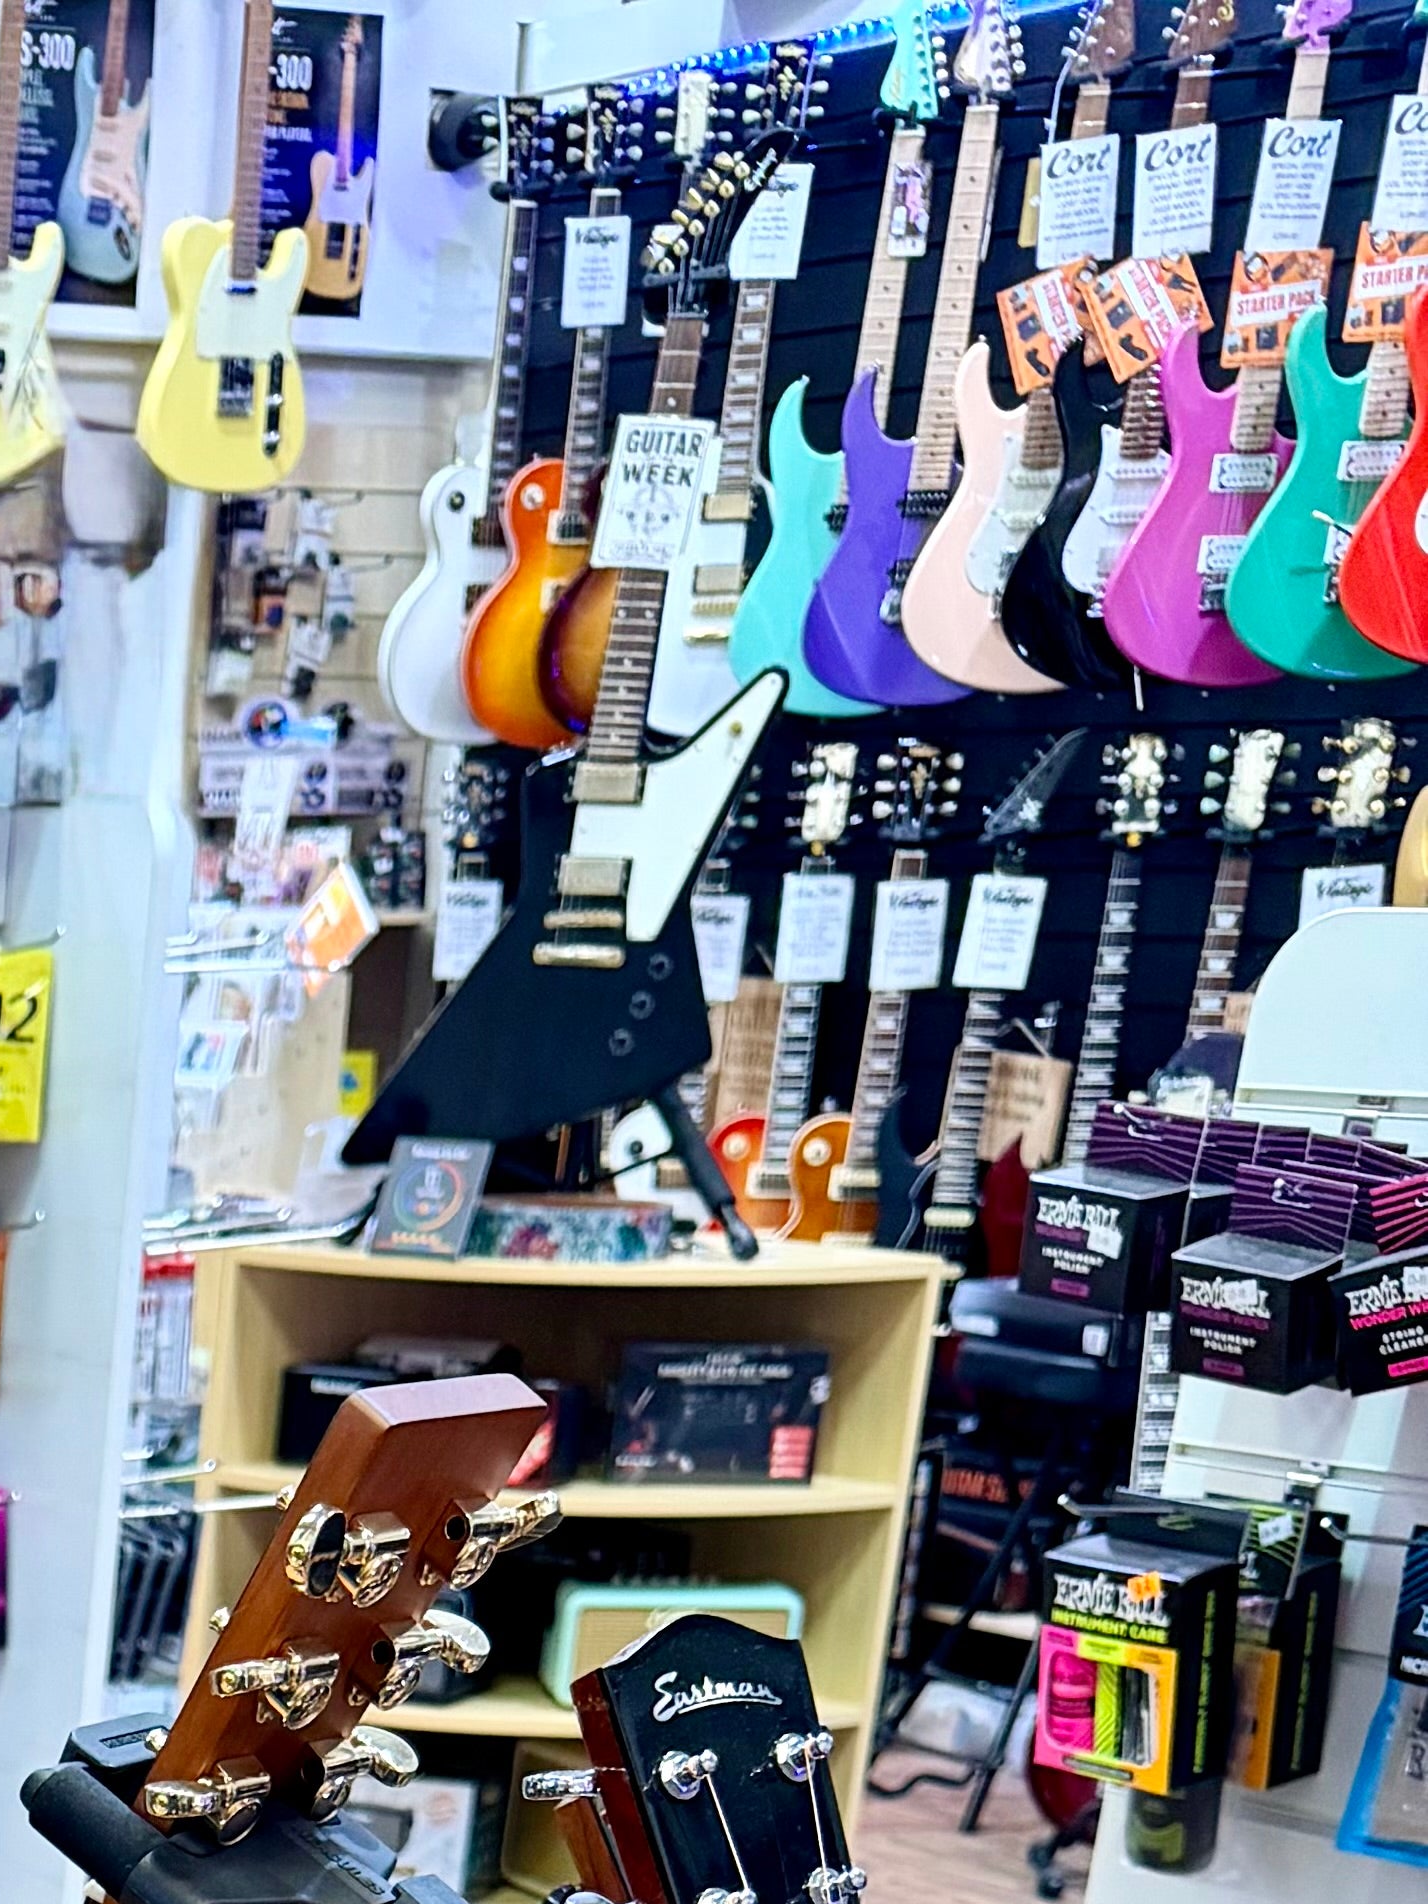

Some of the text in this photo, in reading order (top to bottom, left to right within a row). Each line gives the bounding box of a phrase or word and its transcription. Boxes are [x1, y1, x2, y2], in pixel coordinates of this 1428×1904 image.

[20, 30, 76, 71] S-300
[1144, 134, 1211, 172] Cort
[1268, 126, 1333, 158] Cort
[1046, 143, 1111, 179] Cort
[626, 429, 703, 457] GUITAR
[622, 463, 694, 487] WEEK
[1037, 1194, 1081, 1231] ERNIE
[1344, 1274, 1402, 1317] ERNIE
[1349, 1306, 1407, 1330] WONDER
[1053, 1573, 1117, 1617] ERNIE
[1051, 1606, 1169, 1644] INSTRUMENT CARE
[652, 1672, 784, 1722] Eastman
